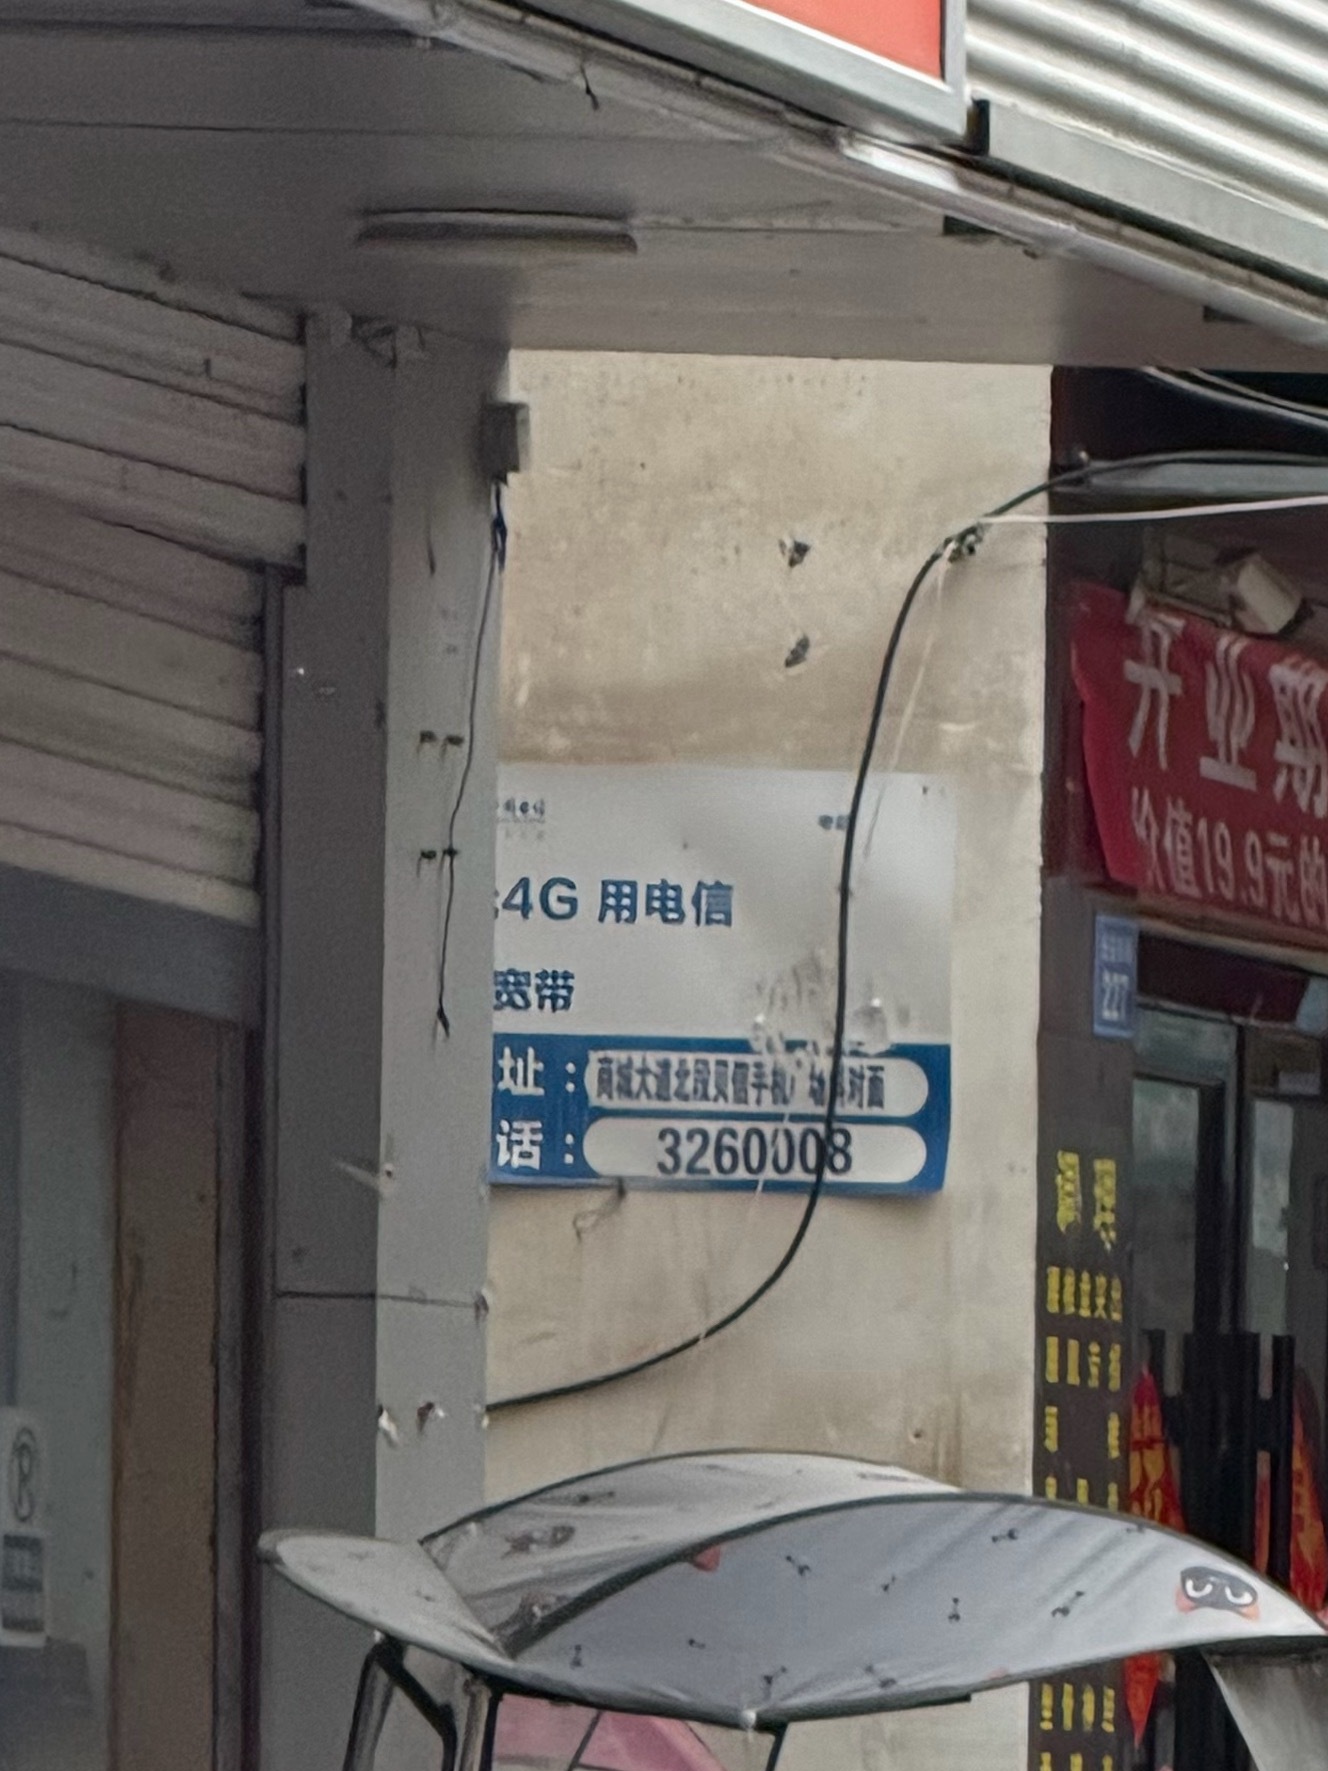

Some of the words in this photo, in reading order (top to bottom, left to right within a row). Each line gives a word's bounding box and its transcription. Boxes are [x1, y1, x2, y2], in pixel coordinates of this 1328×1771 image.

[494, 876, 579, 921] 4G
[597, 878, 735, 926] 用电信
[493, 967, 575, 1013] 宽带
[656, 1126, 854, 1177] 3260008
